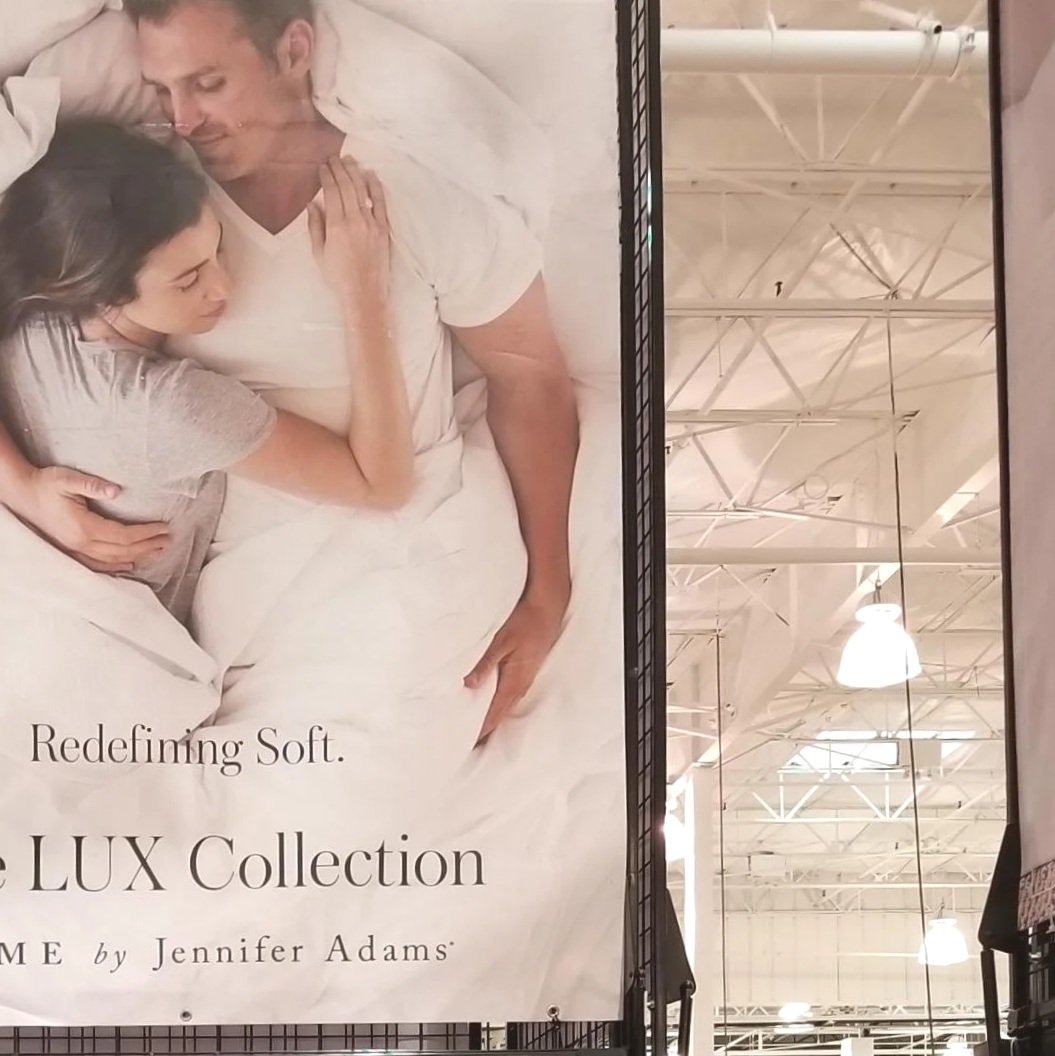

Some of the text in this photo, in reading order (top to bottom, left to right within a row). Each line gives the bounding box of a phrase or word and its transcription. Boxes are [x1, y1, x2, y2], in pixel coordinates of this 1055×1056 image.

[30, 723, 345, 778] Redefining Soft.
[29, 834, 167, 892] LUX
[189, 831, 487, 891] Collection
[94, 942, 128, 974] by
[152, 935, 304, 972] Jennifer
